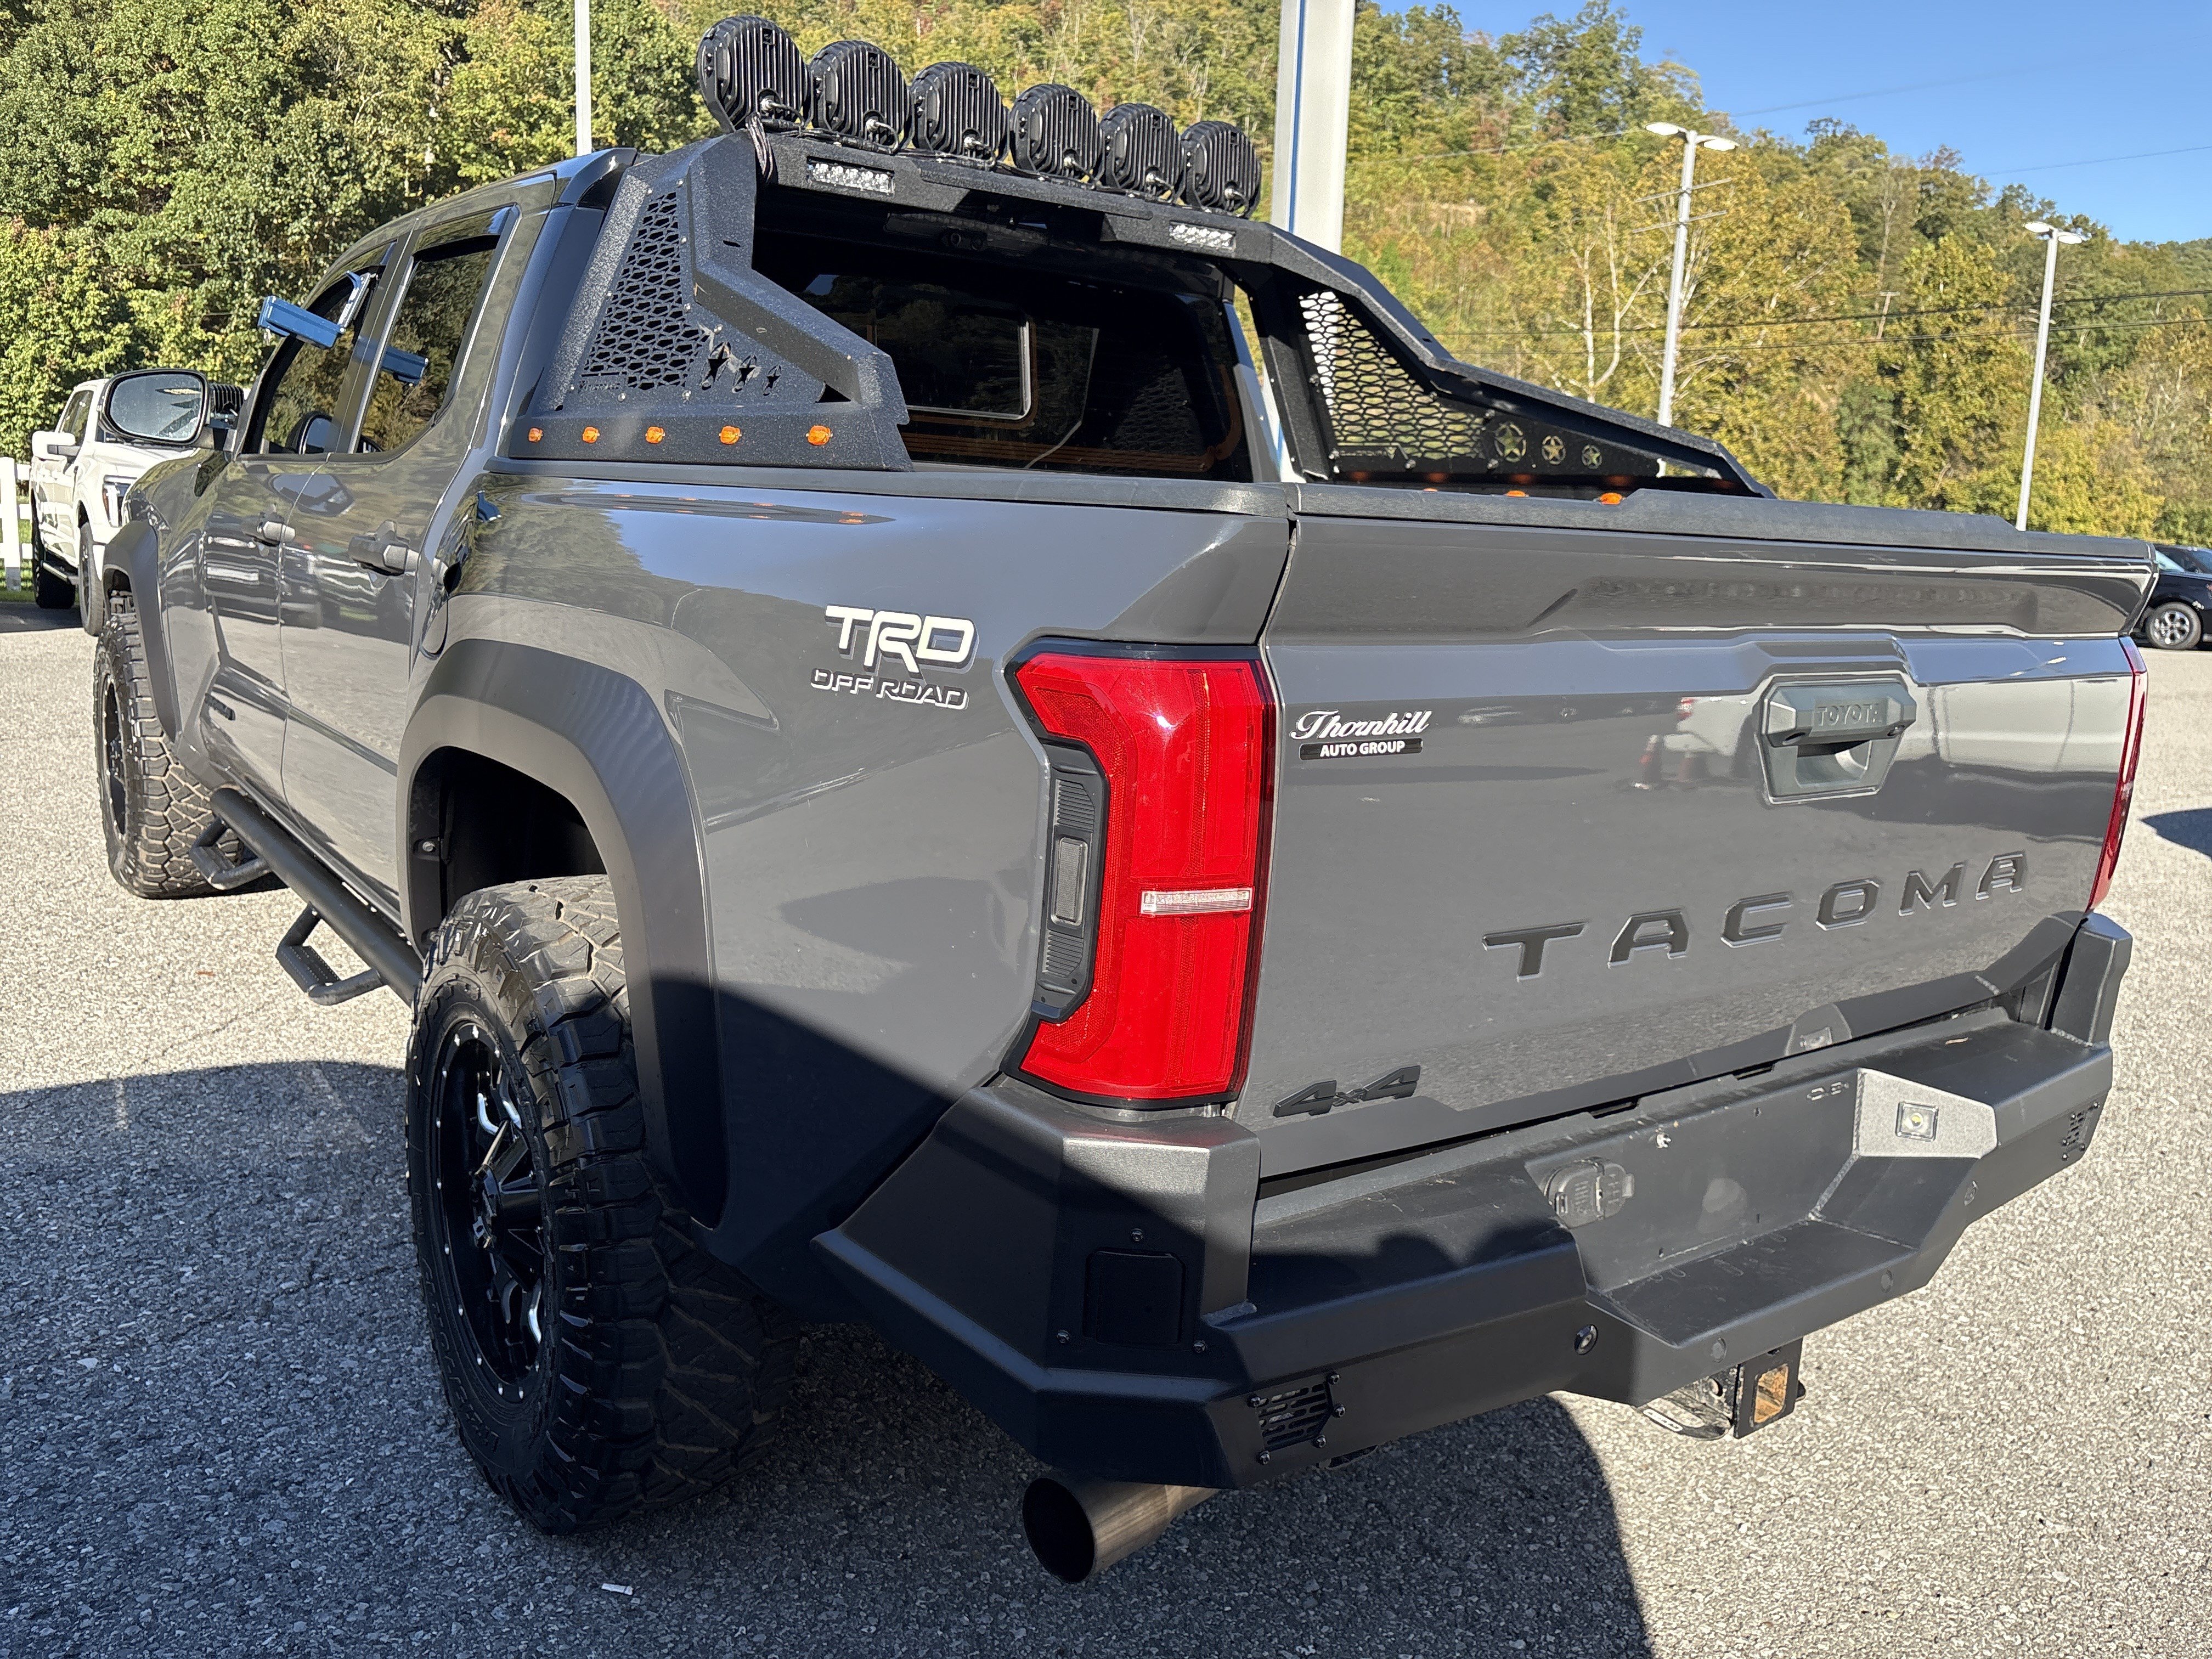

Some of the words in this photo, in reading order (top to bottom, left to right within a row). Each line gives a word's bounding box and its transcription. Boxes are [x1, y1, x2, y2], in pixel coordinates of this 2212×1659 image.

[825, 605, 976, 676] TRD
[811, 668, 873, 695] OFF
[876, 678, 969, 710] ROAD
[1290, 709, 1432, 740] Thornhill
[1319, 743, 1357, 758] AUTO
[1359, 740, 1406, 755] GROUP
[1482, 850, 2027, 983] TACOMA
